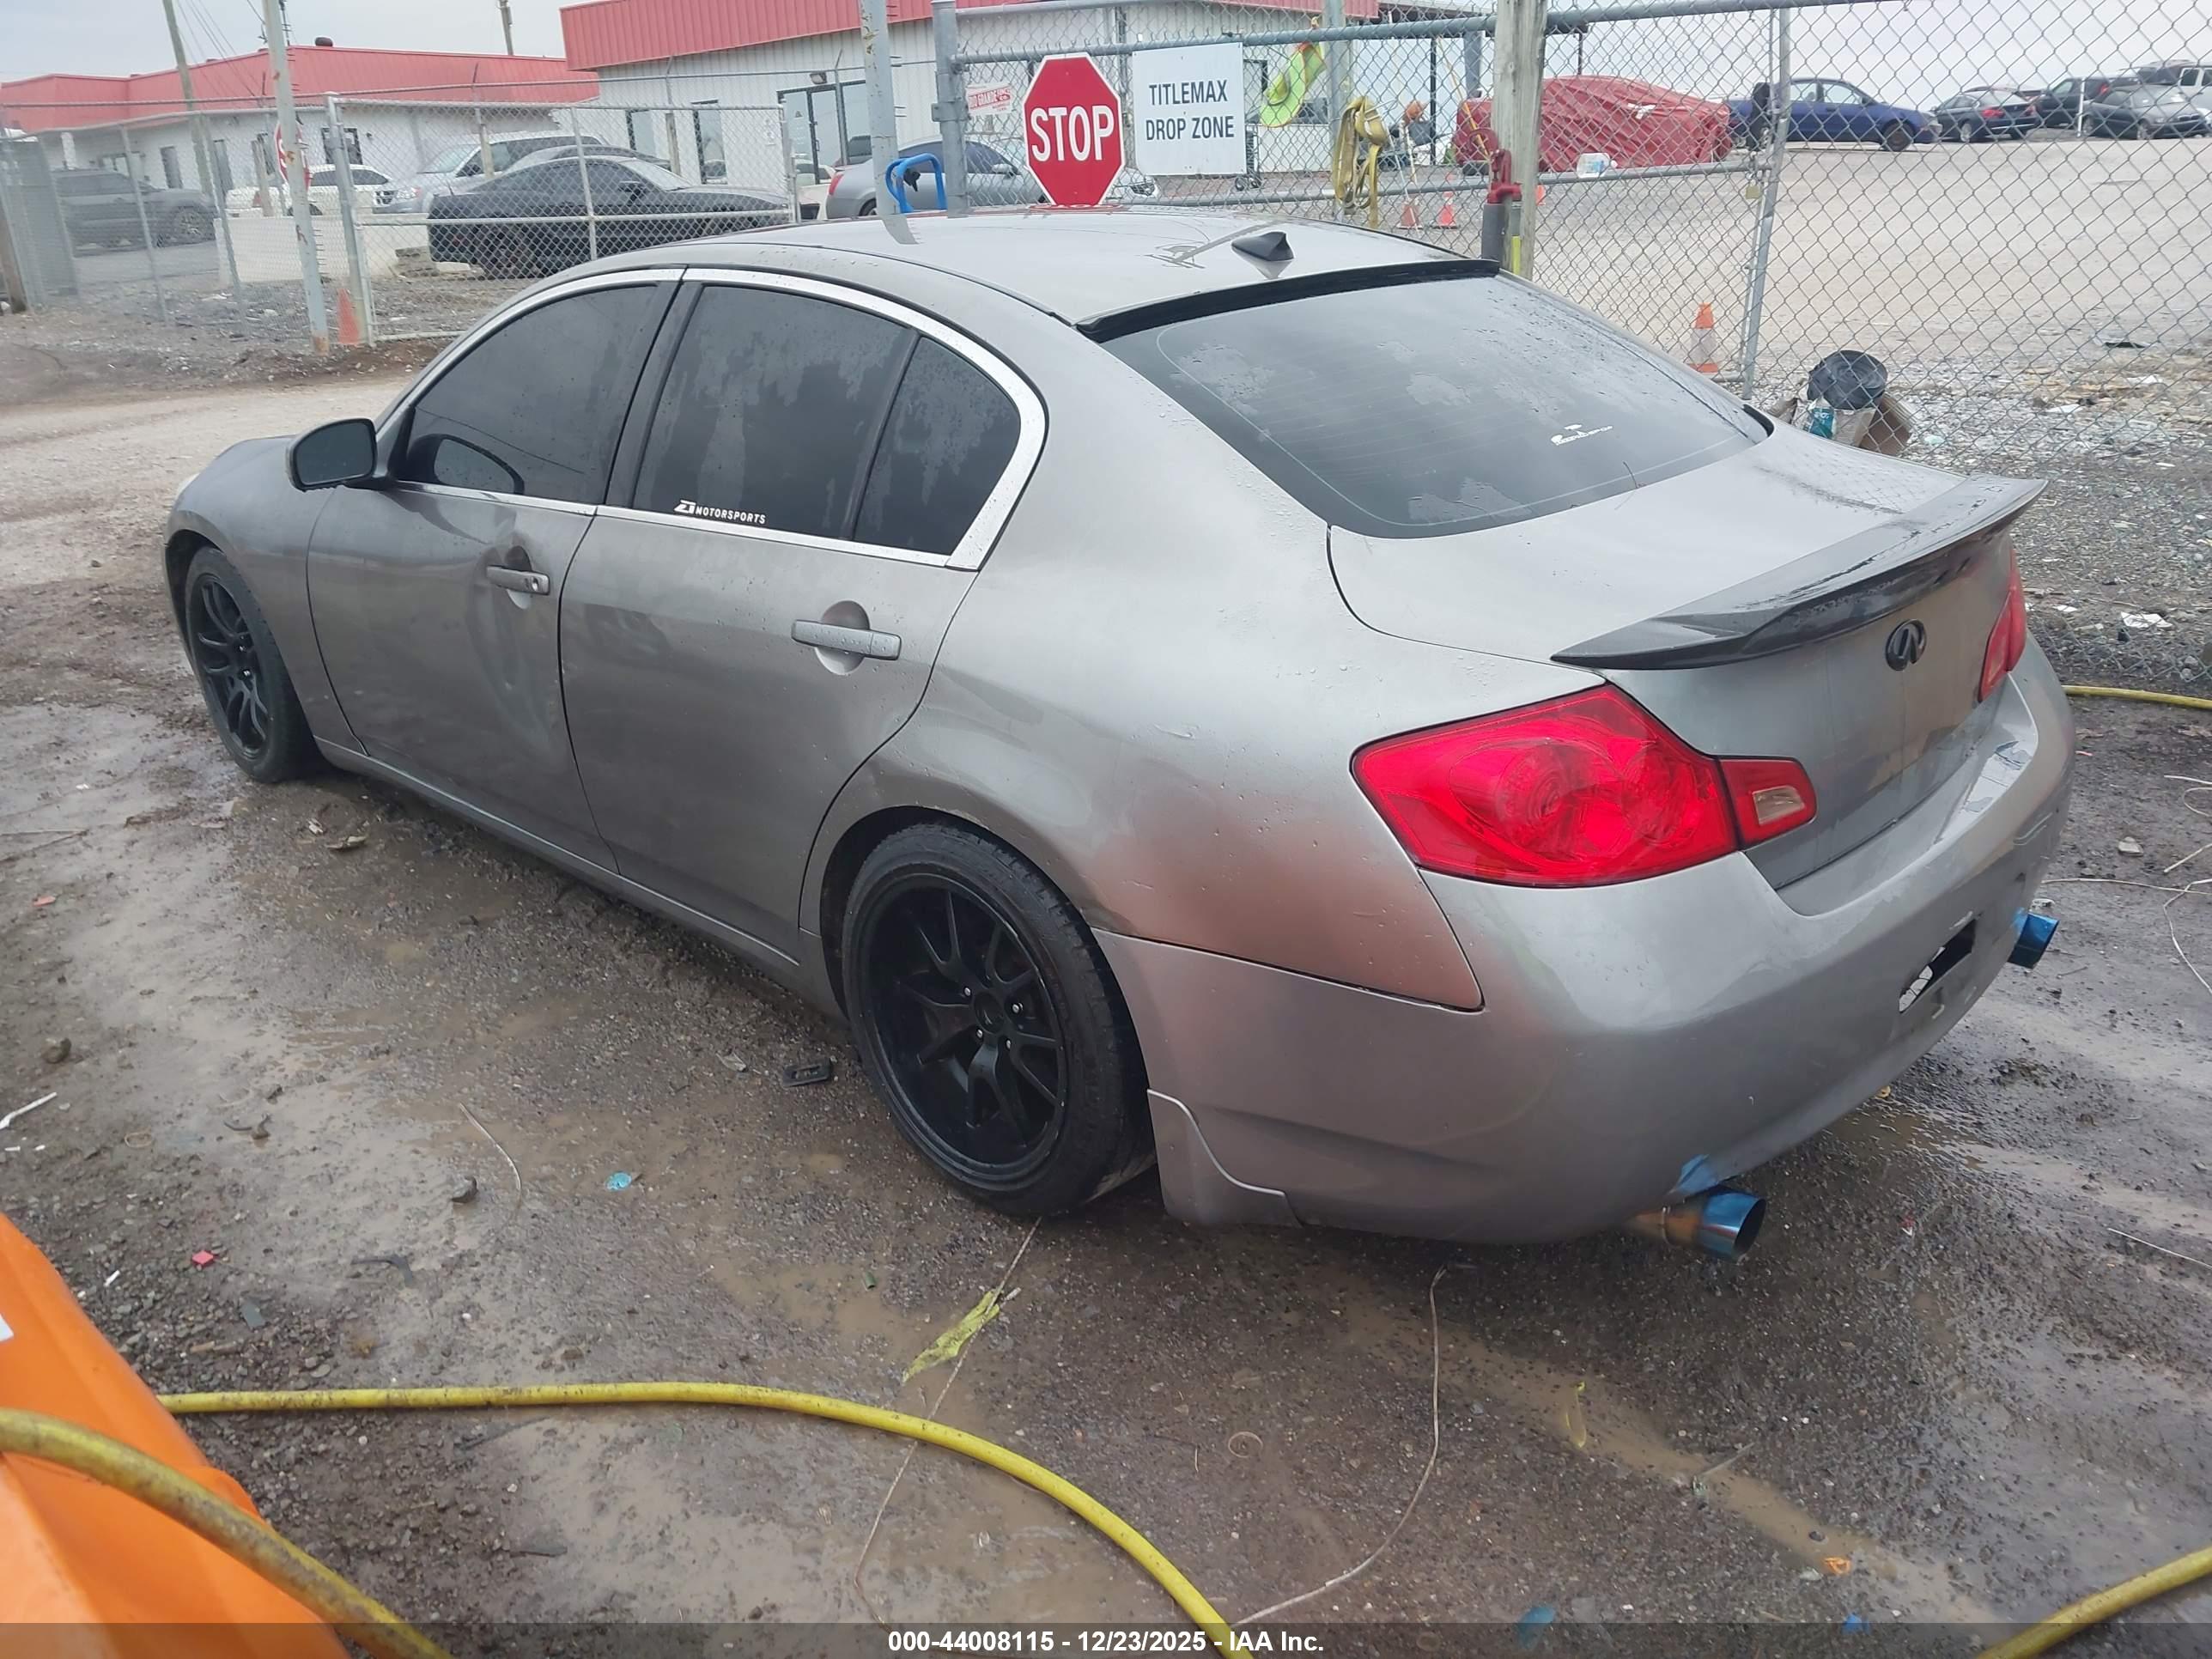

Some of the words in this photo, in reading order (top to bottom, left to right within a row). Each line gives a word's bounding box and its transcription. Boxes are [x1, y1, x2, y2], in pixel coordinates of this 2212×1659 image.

[1149, 80, 1228, 106] TITLEMAX
[1030, 105, 1115, 162] STOP
[1146, 118, 1186, 141] DROP
[1192, 115, 1235, 139] ZONE
[696, 506, 766, 525] MOTORSPORTS
